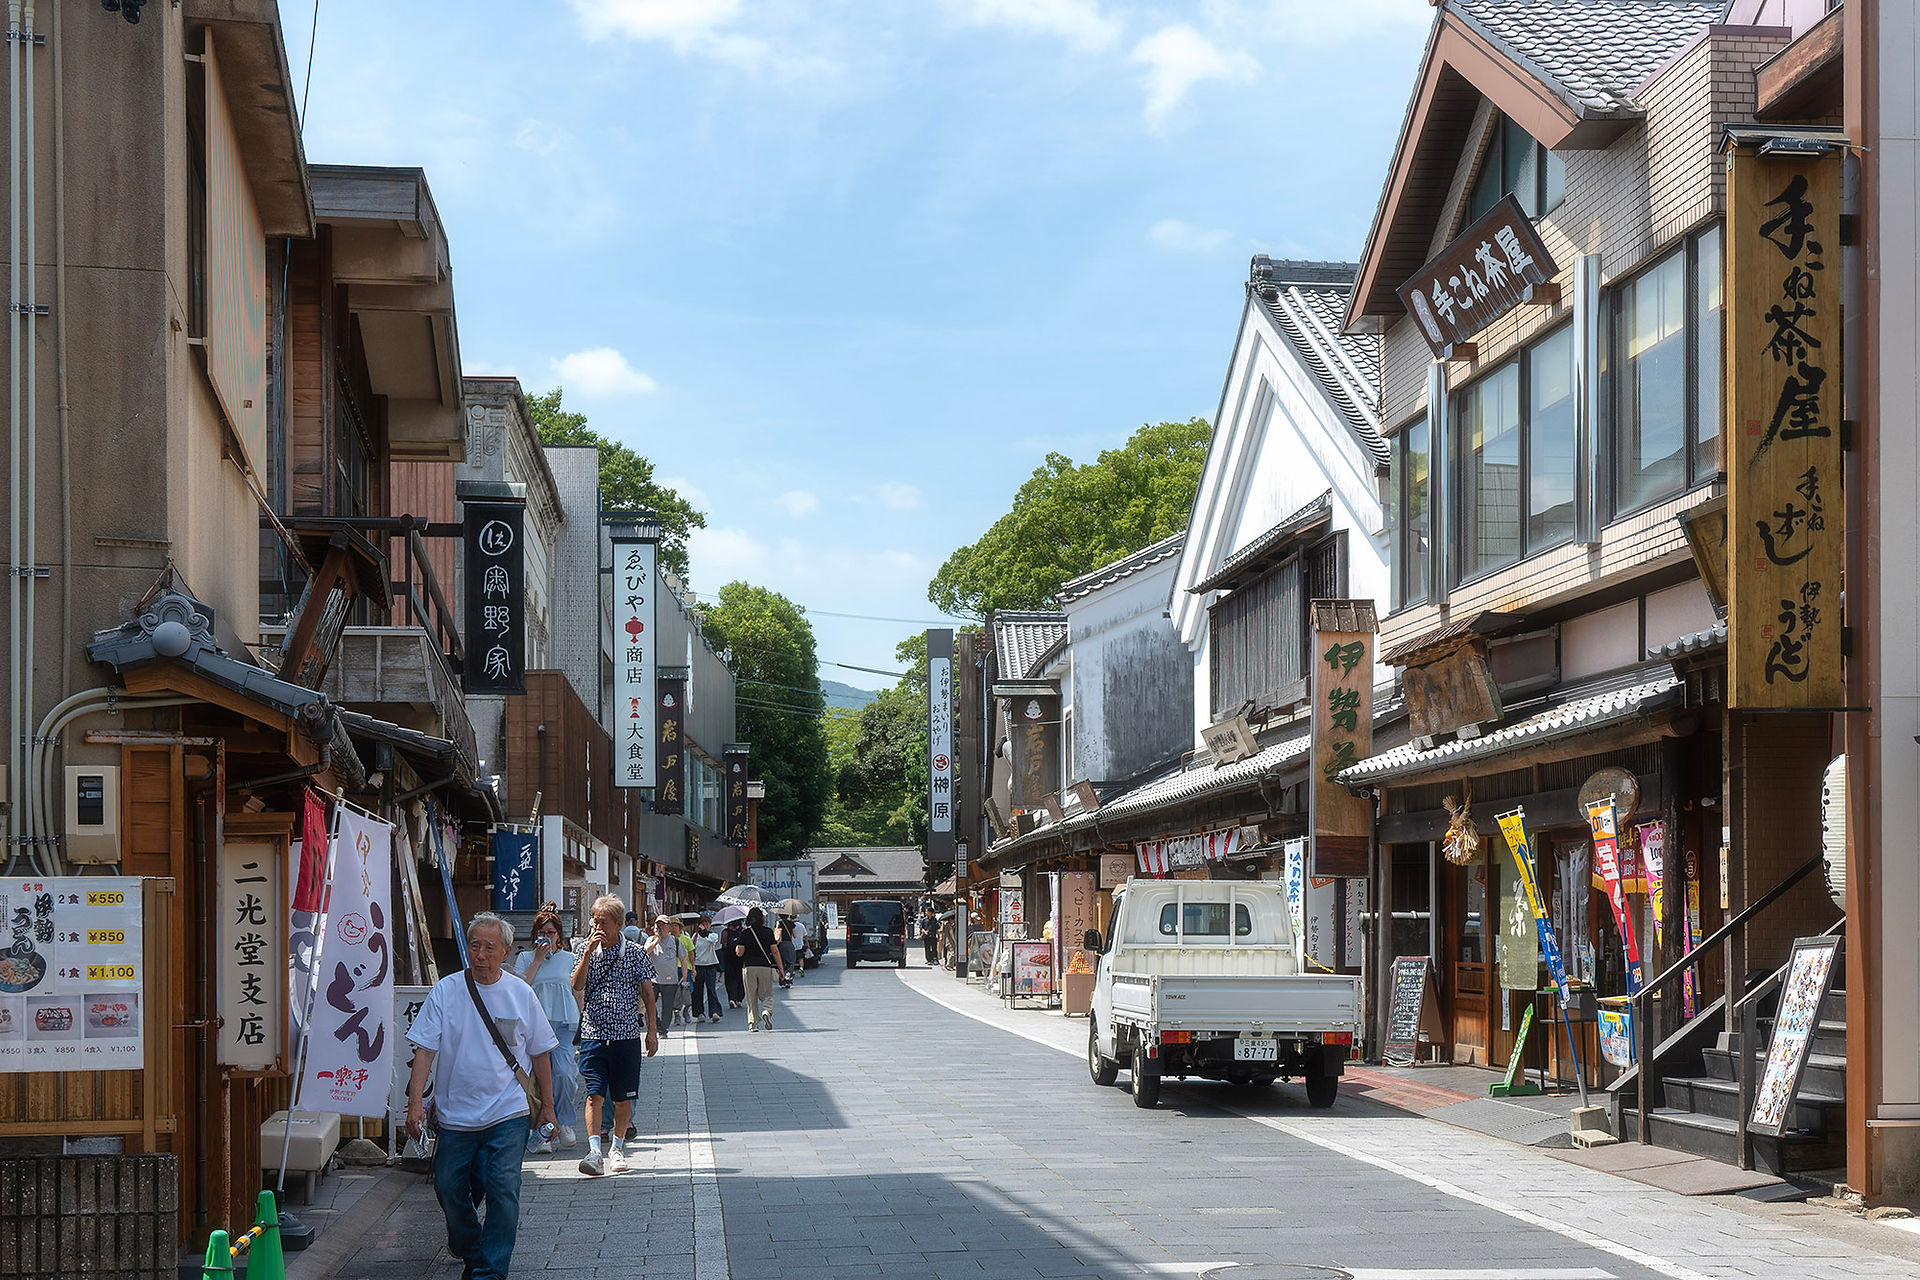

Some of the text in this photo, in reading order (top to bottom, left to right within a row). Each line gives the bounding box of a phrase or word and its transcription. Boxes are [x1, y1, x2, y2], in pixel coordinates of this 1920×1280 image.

[1431, 224, 1534, 326] 手こね茶屋
[1755, 503, 1814, 566] ずし
[1800, 581, 1822, 632] 伊勢
[624, 549, 647, 781] ゑびや 商店 大食堂
[1765, 599, 1812, 685] うどん
[932, 704, 941, 747] おみやげ
[933, 776, 950, 819] 榊原
[88, 893, 124, 904] ¥550
[760, 880, 802, 890] SAGAWA
[11, 907, 35, 955] うどん
[88, 931, 125, 943] ¥850
[1073, 886, 1084, 952] ベビーカステ
[233, 861, 268, 1046] 二光堂支店
[326, 901, 389, 1064] うどん
